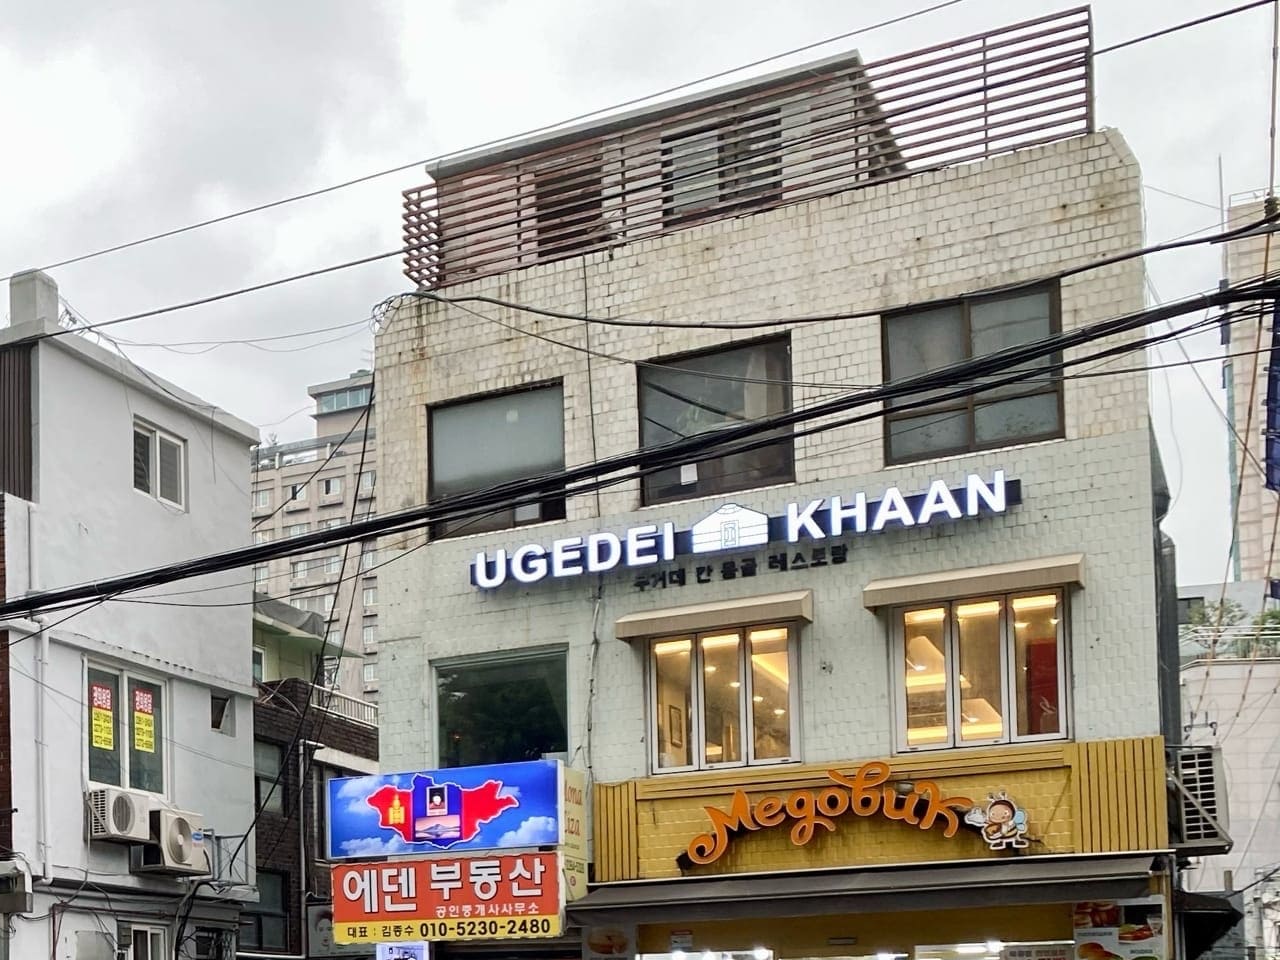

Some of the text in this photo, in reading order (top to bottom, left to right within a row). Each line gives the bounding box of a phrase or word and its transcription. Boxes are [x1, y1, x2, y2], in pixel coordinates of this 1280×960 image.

[474, 469, 1008, 589] UGEDEI KHAAN
[768, 543, 849, 573] 레스토랑
[342, 857, 547, 913] 에덴 부동산
[435, 902, 540, 919] 공인중개사사무소
[347, 925, 368, 938] 대표
[381, 924, 415, 938] 김종수
[420, 918, 551, 938] 010-5230-2480
